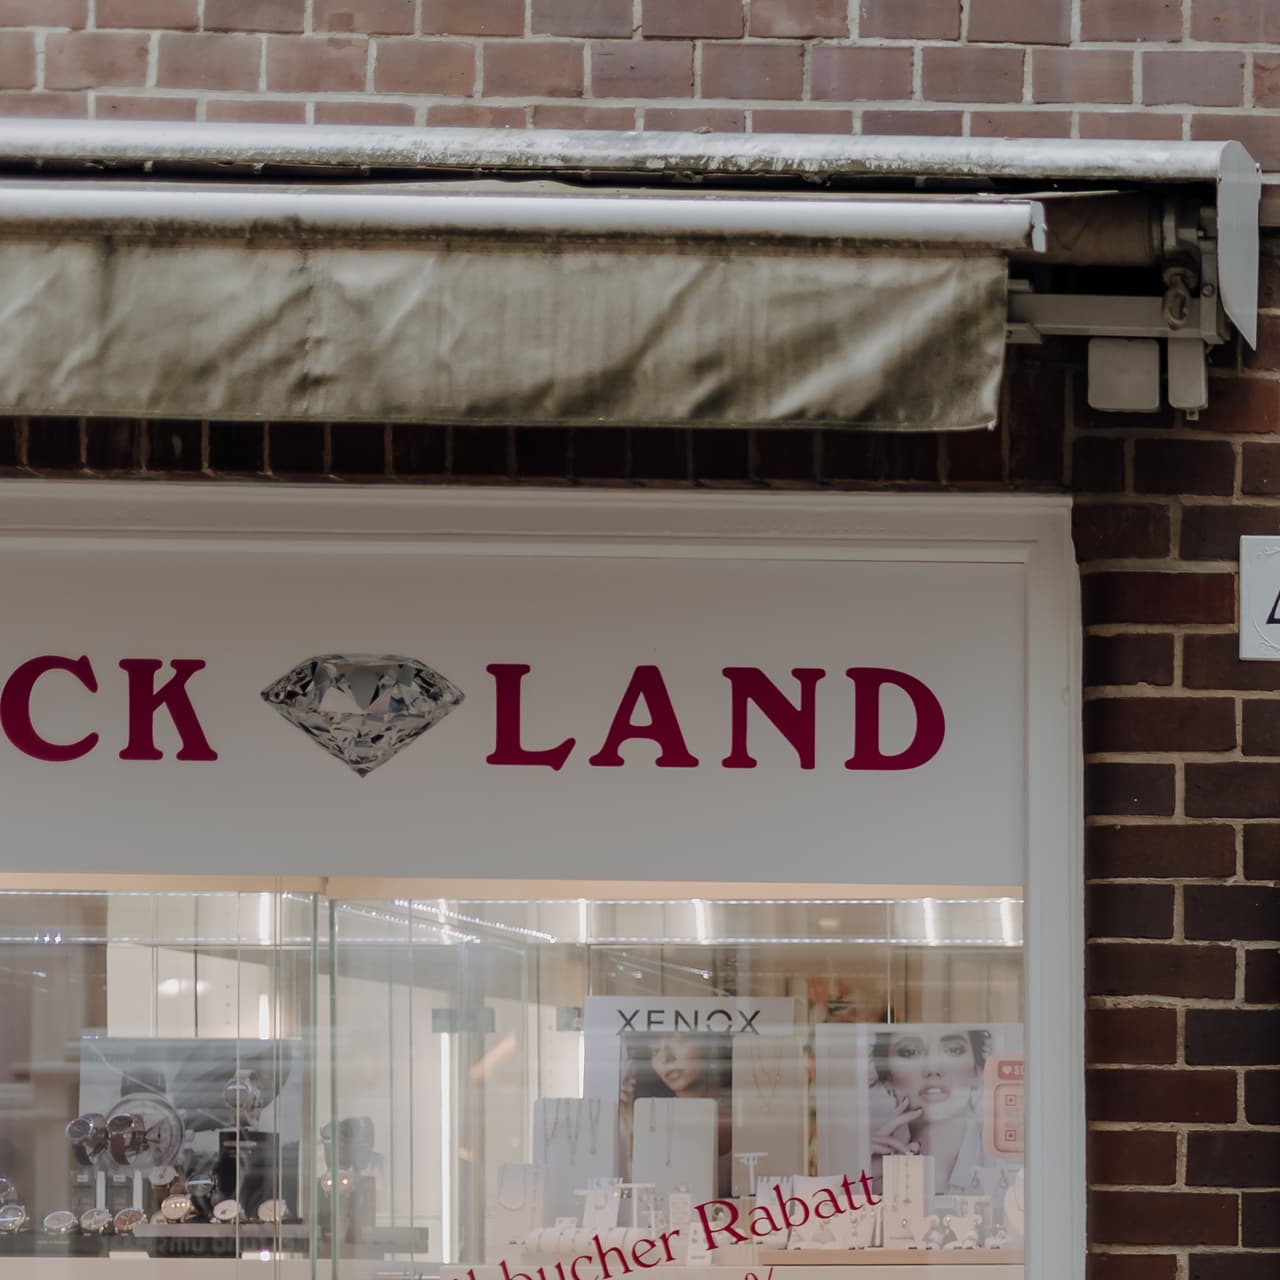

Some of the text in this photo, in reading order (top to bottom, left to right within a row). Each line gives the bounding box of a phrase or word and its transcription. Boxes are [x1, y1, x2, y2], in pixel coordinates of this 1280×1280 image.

[485, 663, 946, 771] LAND
[617, 1009, 760, 1035] XENOX
[694, 1169, 882, 1251] Rabatt
